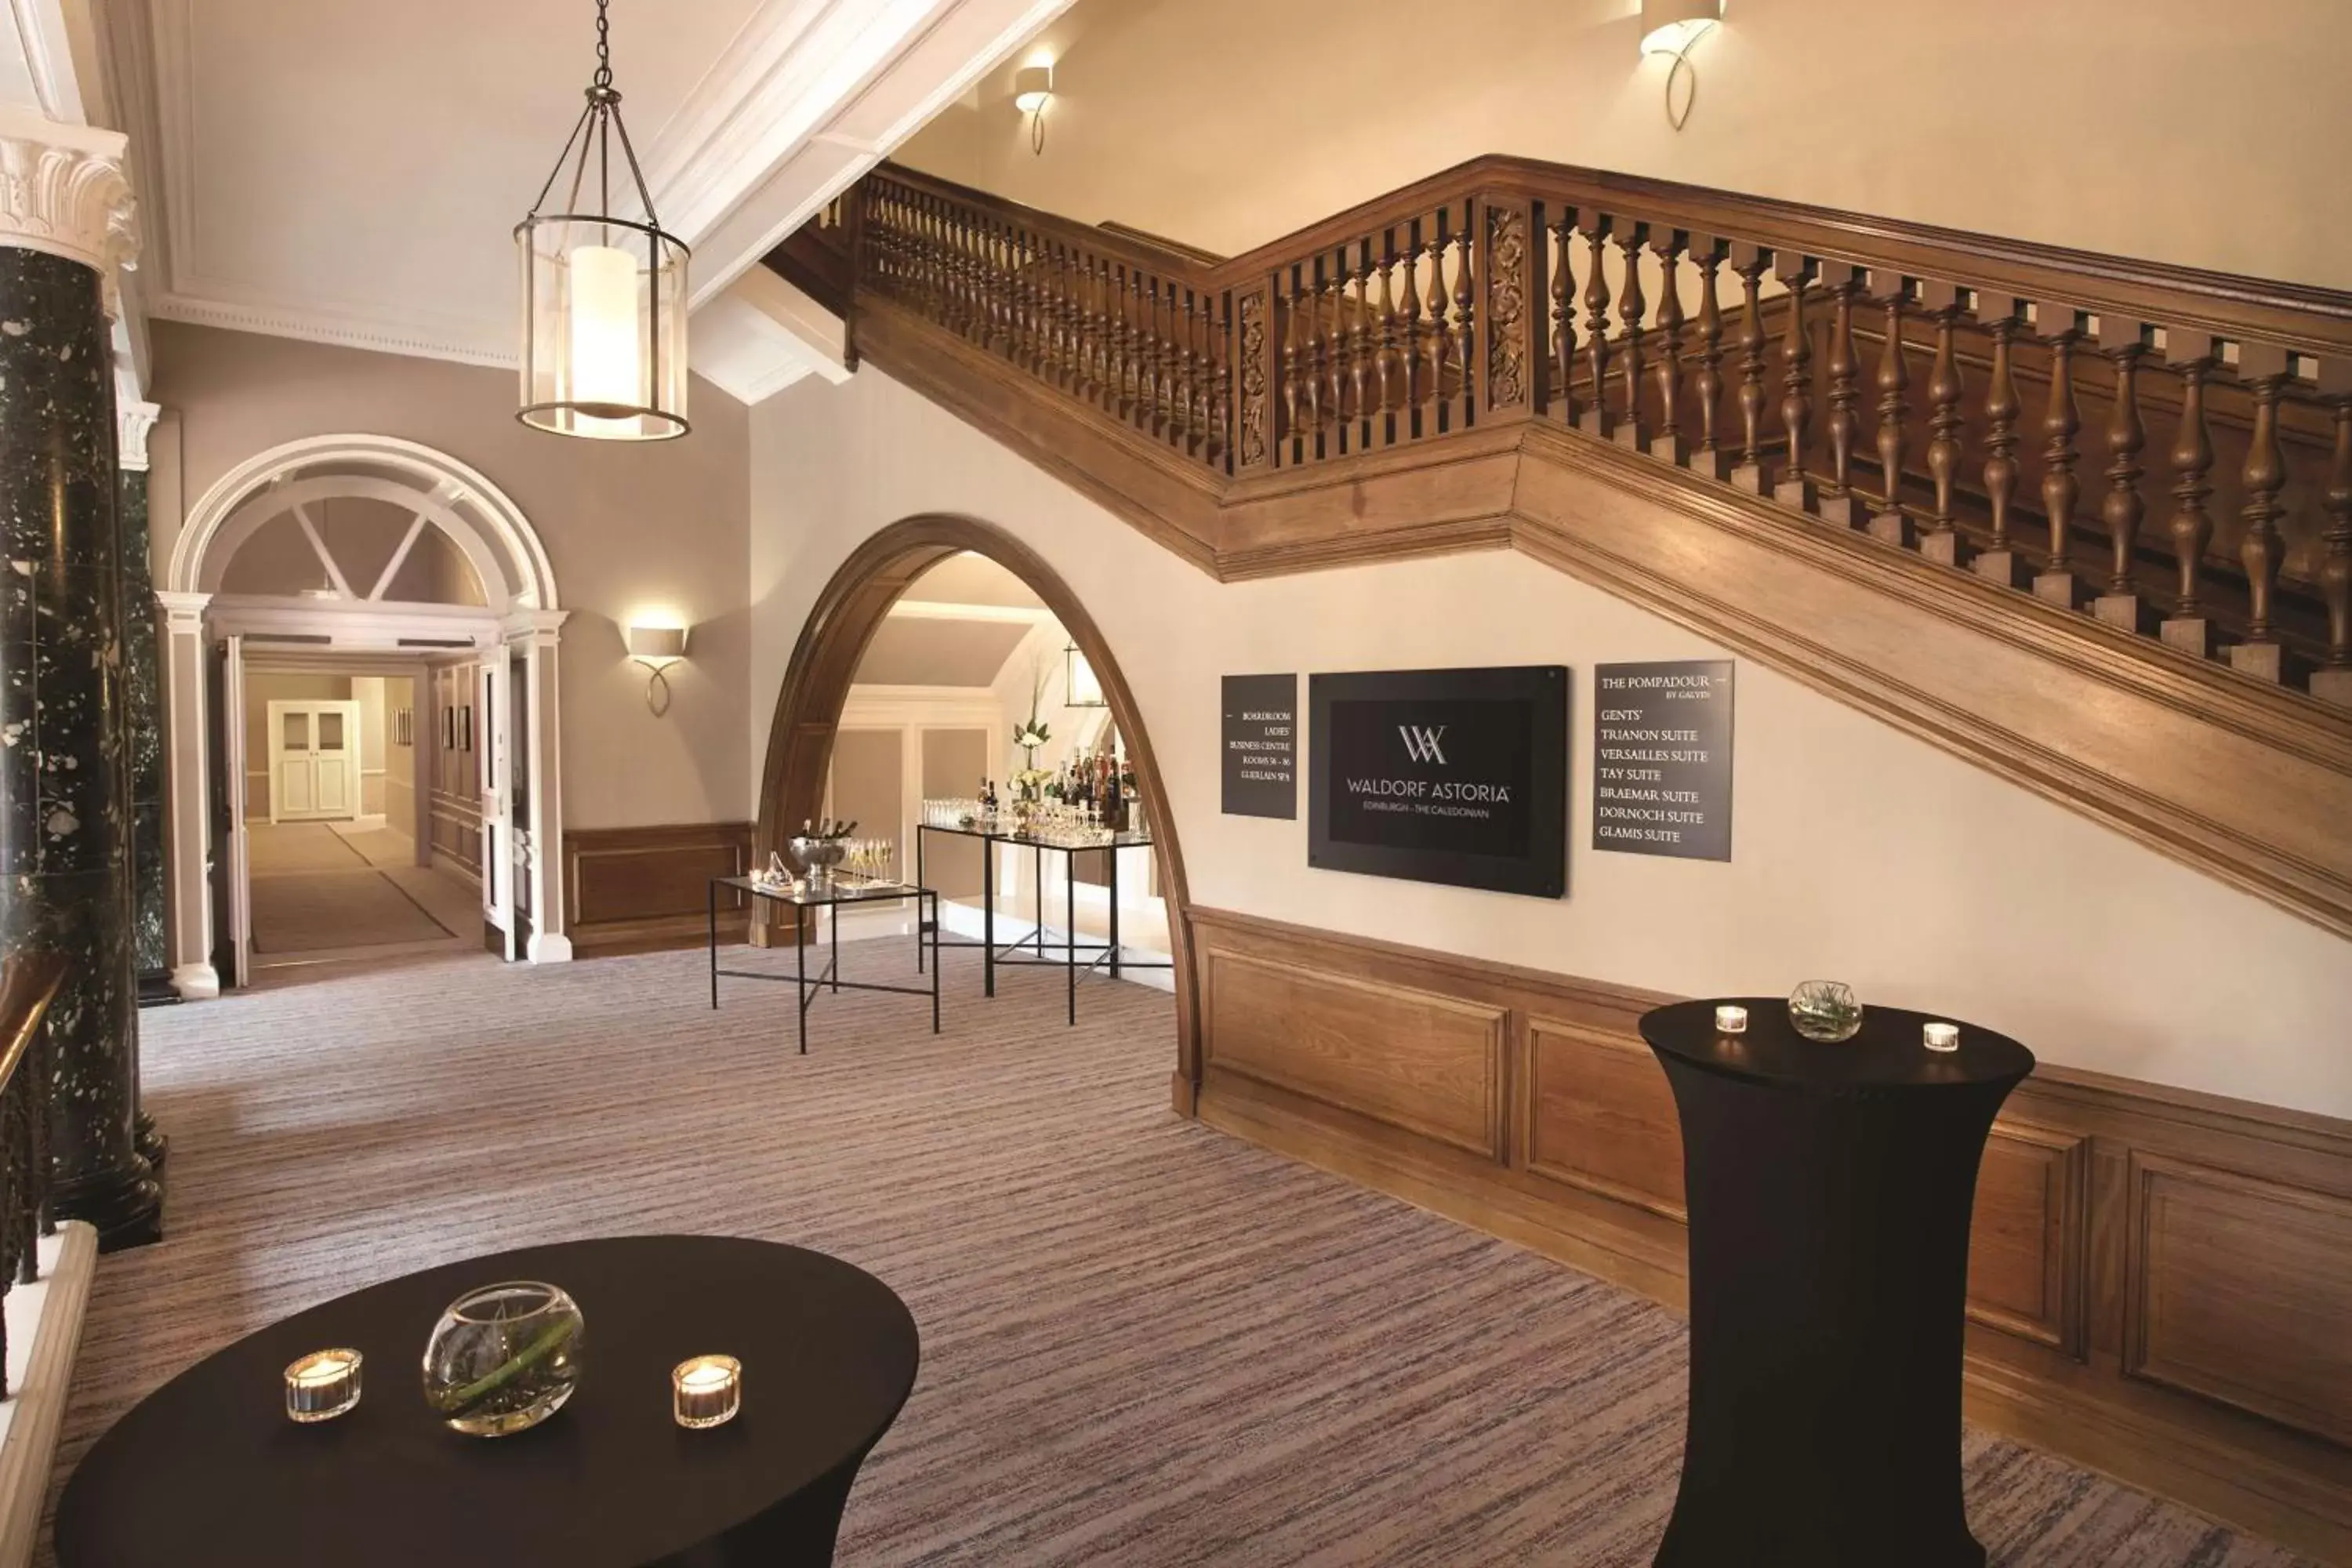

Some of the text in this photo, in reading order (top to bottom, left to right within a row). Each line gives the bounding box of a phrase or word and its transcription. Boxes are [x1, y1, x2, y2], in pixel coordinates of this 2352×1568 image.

[1602, 676, 1709, 689] THE POMPADOUR
[1666, 691, 1677, 699] BY
[1243, 712, 1290, 720] BOARDROOM
[1601, 729, 1698, 742] TRIANON SUITE
[1229, 741, 1290, 750] BUSINESS CENTRE
[1243, 756, 1269, 764] ROOMS
[1601, 749, 1708, 763] VERSAILLES SUITE
[1277, 772, 1290, 782] SPA
[1600, 768, 1662, 781] TAY SUITE
[1346, 778, 1510, 804] WALDORF ASTORIA
[1600, 787, 1699, 804] BRAEMAR SUITE
[1363, 800, 1409, 813] EDINBURGH
[1414, 804, 1430, 815] THE
[1431, 805, 1490, 819] CALEDONIAN
[1599, 806, 1704, 824] DORNOCH SUITE
[1599, 826, 1681, 843] GLAMIS SUITE
